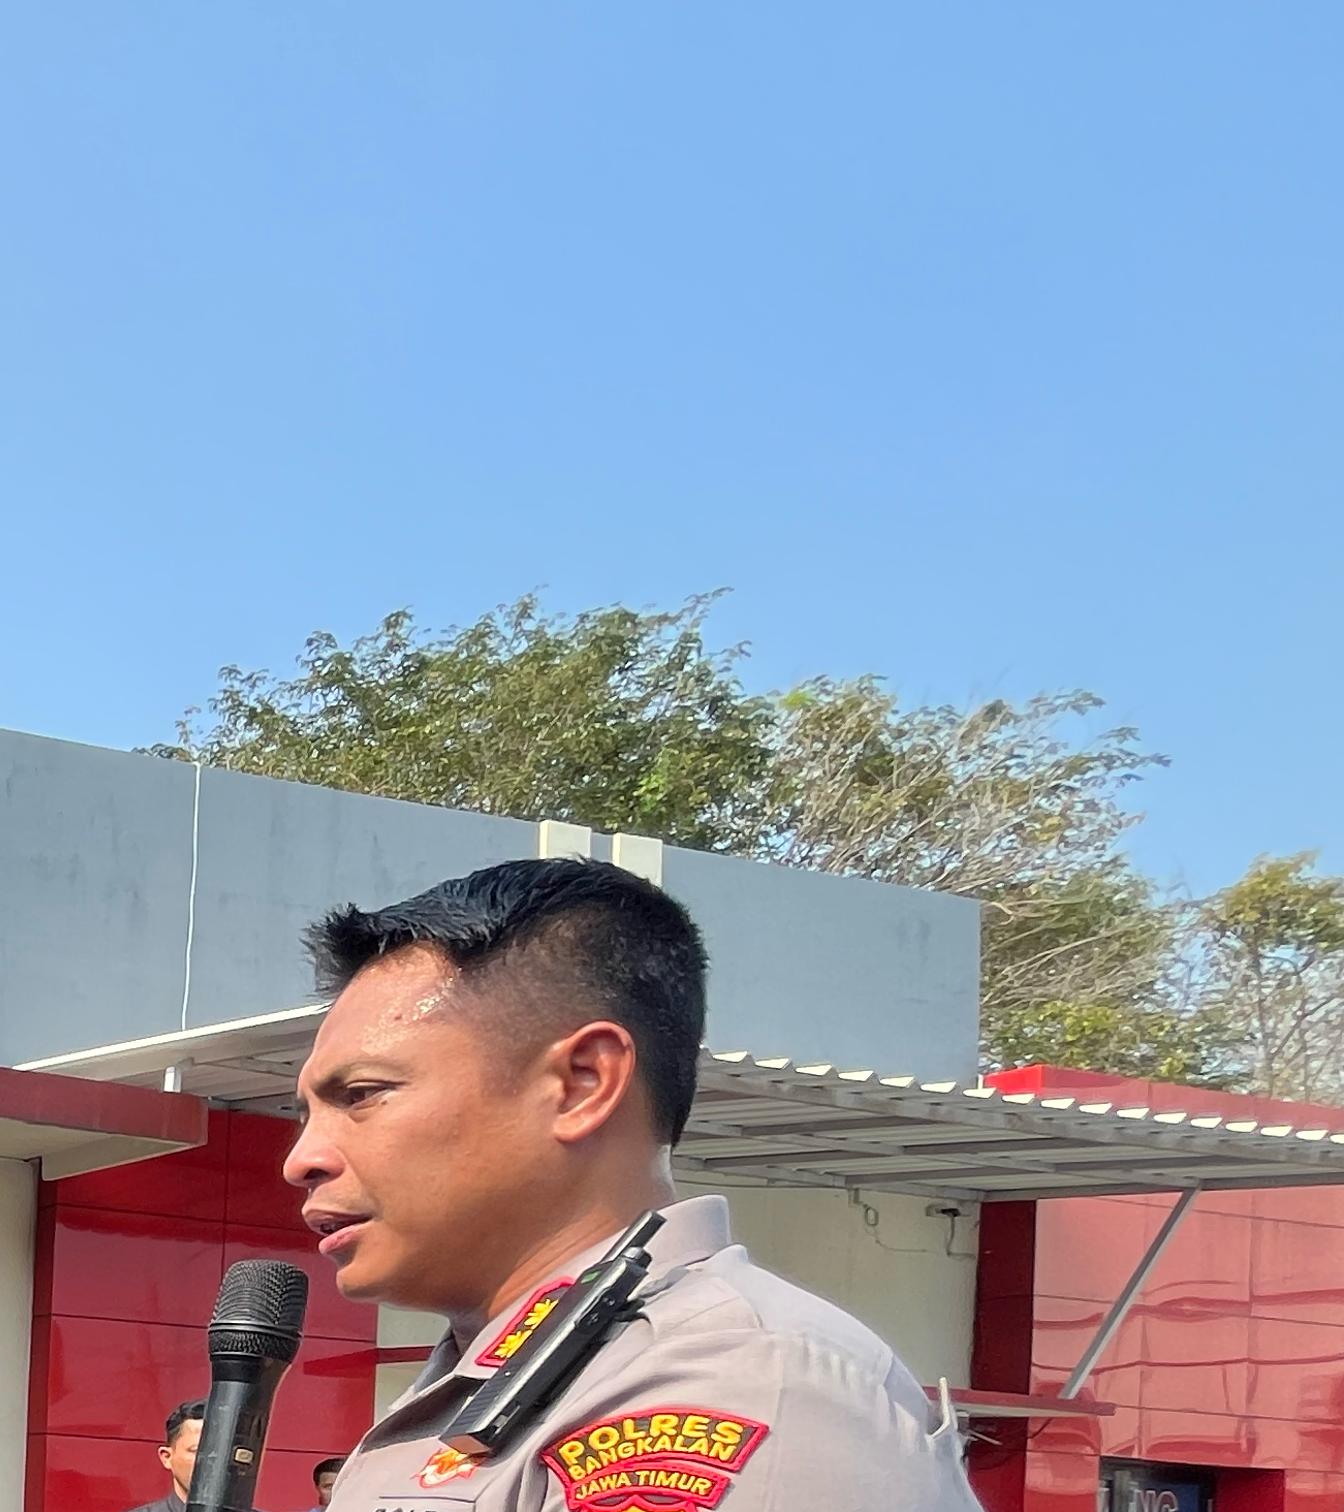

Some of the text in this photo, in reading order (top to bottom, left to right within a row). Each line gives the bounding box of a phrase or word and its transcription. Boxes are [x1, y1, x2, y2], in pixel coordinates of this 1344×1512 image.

[559, 1414, 744, 1466] POLRES
[568, 1435, 737, 1481] BANGKALAN
[575, 1470, 712, 1499] JAWA TIMUR
